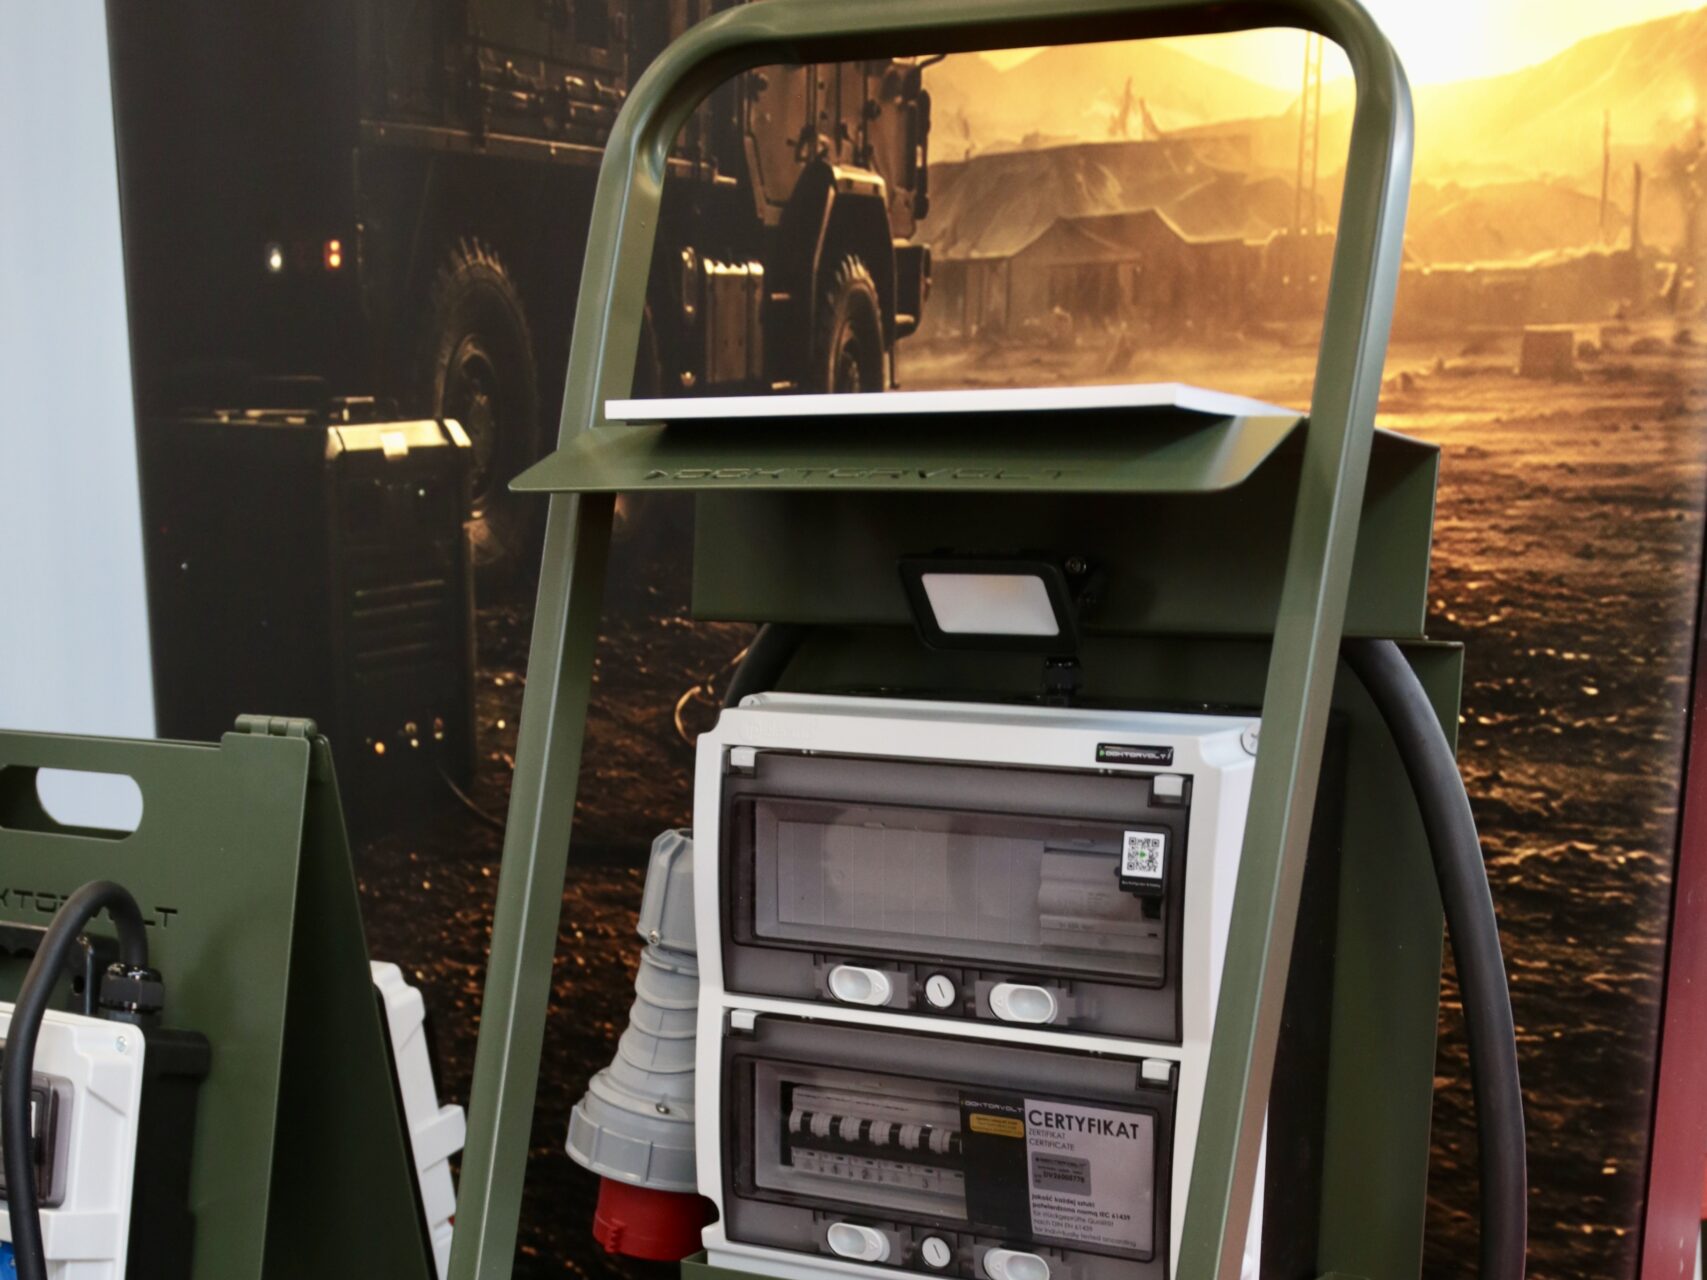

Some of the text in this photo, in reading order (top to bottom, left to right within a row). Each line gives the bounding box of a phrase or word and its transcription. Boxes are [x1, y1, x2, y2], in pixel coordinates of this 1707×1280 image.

[0, 889, 178, 928] KTOT
[1028, 1109, 1139, 1140] CERTYFIKAT
[1029, 1128, 1066, 1140] ZERTIFIKAT
[1029, 1138, 1075, 1152] CERTIFICATE
[1099, 1211, 1110, 1219] IEC
[1112, 1213, 1131, 1221] 61439
